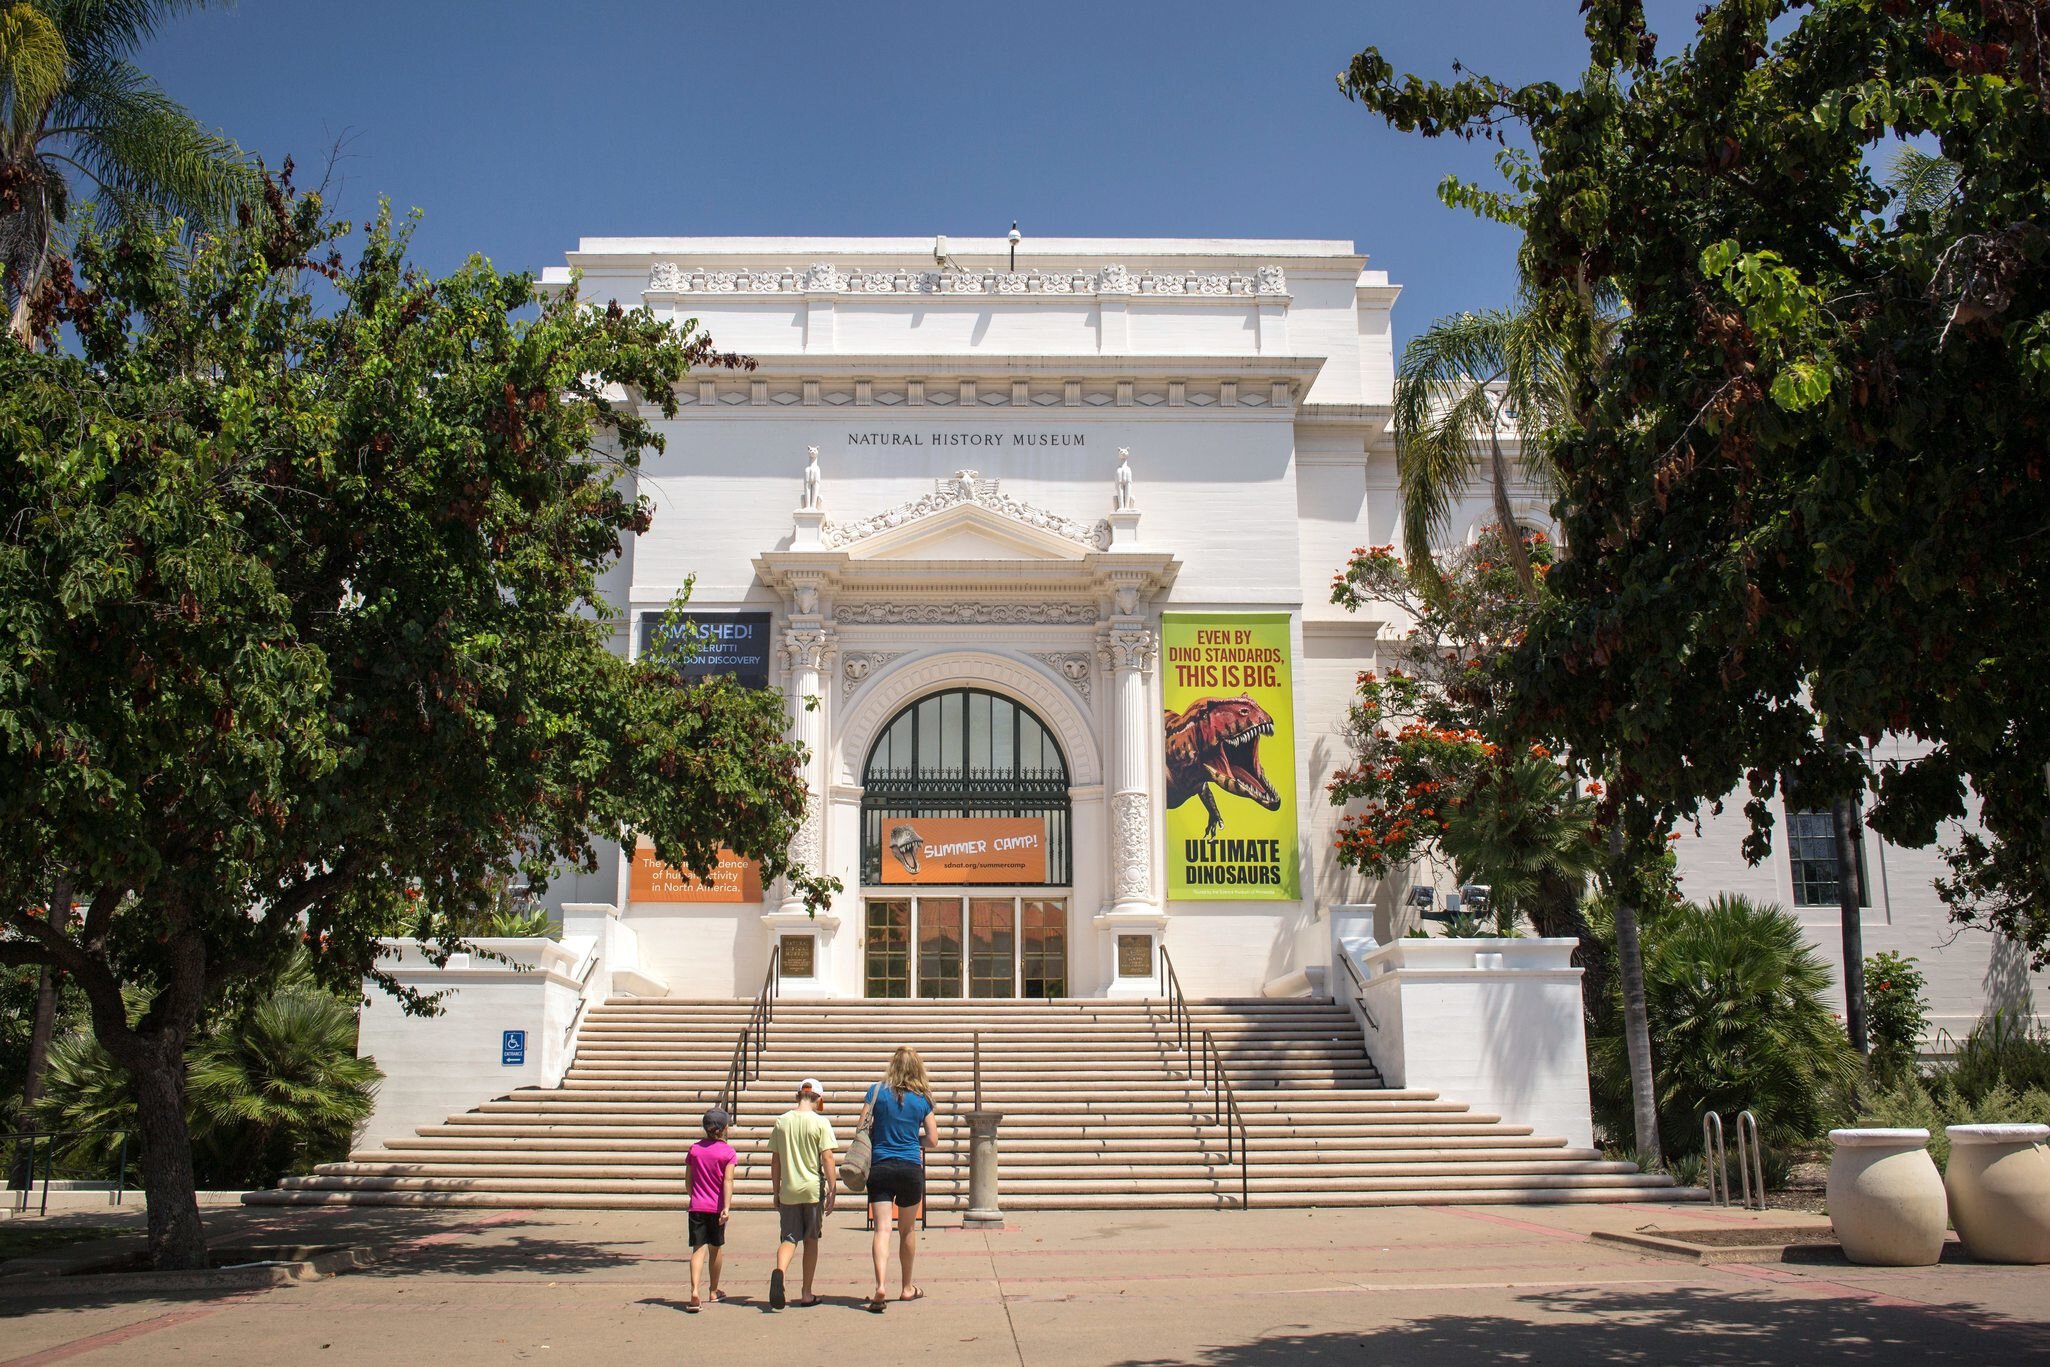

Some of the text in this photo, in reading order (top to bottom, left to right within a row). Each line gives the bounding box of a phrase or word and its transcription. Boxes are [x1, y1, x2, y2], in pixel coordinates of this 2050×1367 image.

[848, 433, 1085, 446] NATURAL HISTORY MUSEUM
[1197, 630, 1252, 645] EVEN BY
[708, 656, 761, 665] DISCOVERY
[1169, 647, 1284, 664] DINO STANDARDS,
[1175, 665, 1282, 687] THIS IS BIG.
[924, 835, 1038, 858] SUMMER CAMP!
[1185, 839, 1280, 862] ULTIMATE
[643, 859, 661, 868] The
[944, 862, 1026, 870] sdnat.org/summercamp
[652, 870, 663, 879] of
[1186, 865, 1281, 884] DINOSAURS
[652, 883, 661, 891] in
[664, 882, 694, 892] North
